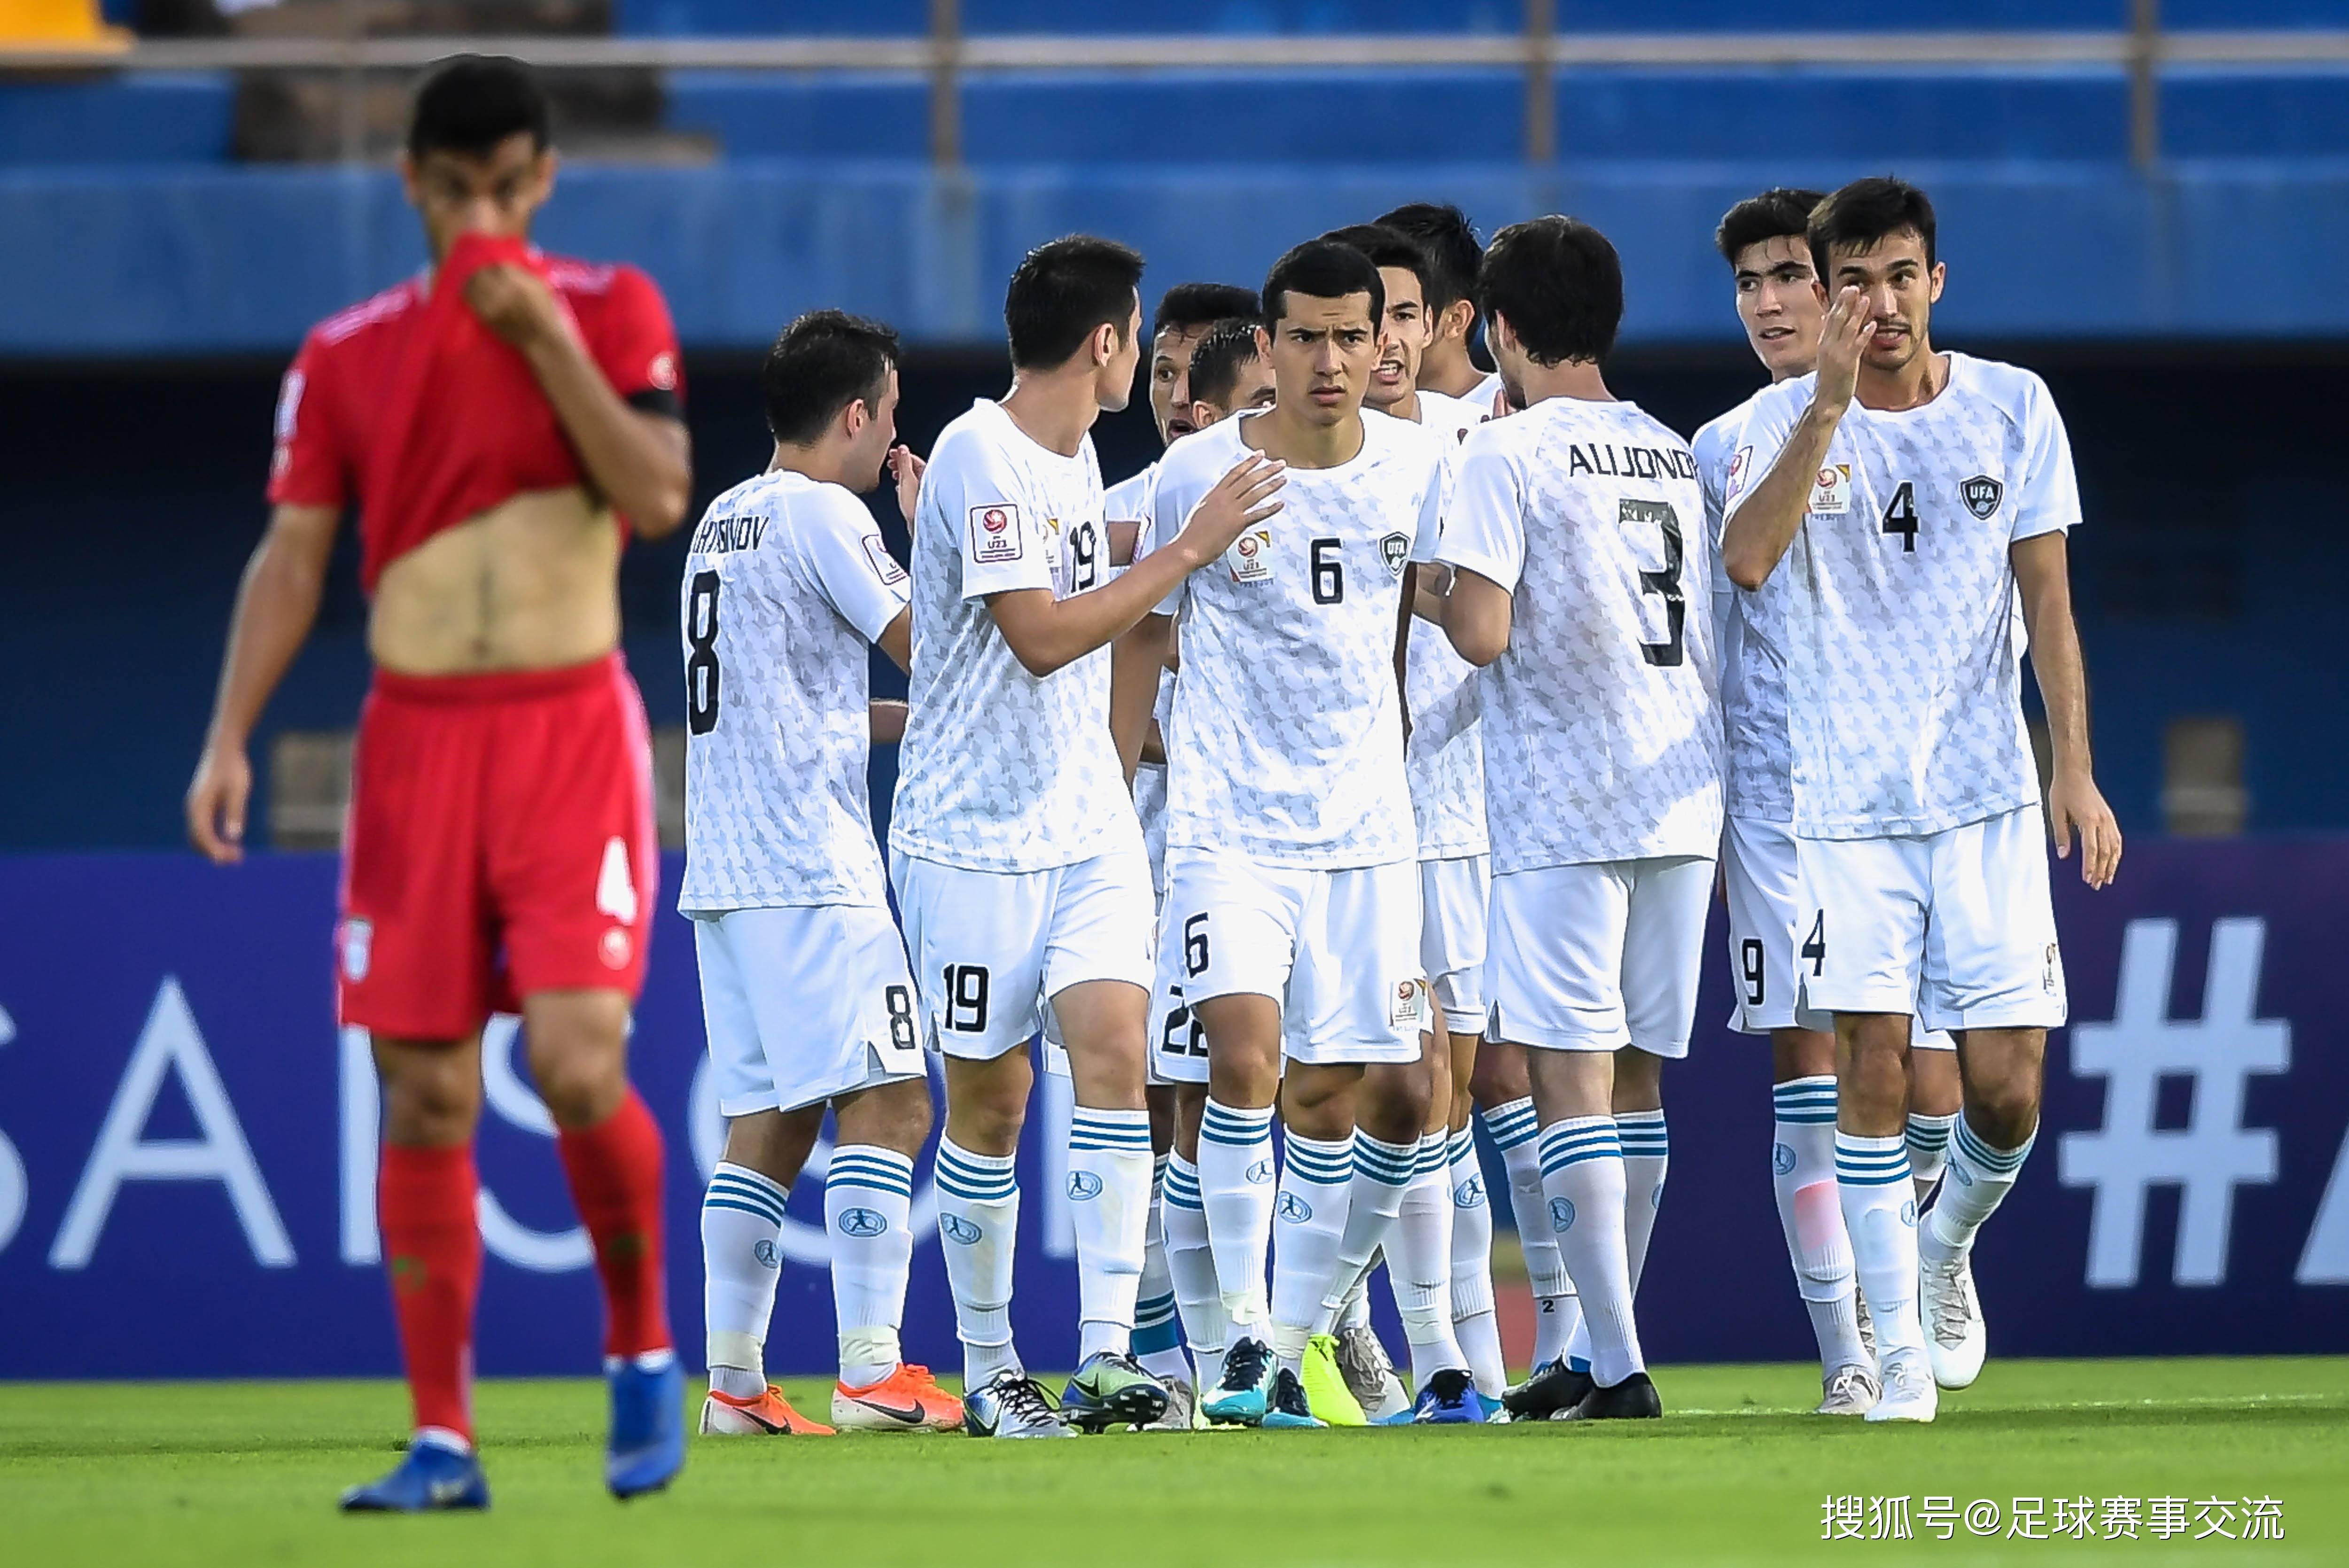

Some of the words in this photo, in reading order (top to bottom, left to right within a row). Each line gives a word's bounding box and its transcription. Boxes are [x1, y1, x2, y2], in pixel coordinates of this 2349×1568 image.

[1570, 443, 1699, 479] ALIJONO
[1970, 485, 1995, 499] UFA
[1882, 482, 1919, 552] 4
[1069, 520, 1097, 593] 19
[1311, 538, 1343, 605] 6
[1619, 498, 1685, 667] 3
[688, 569, 720, 736] 8
[1185, 912, 1209, 978] 6
[1742, 938, 1765, 1005] 9
[1801, 909, 1826, 977] 4
[886, 985, 916, 1050] 8
[944, 963, 989, 1032] 19
[1541, 1299, 1555, 1313] 2
